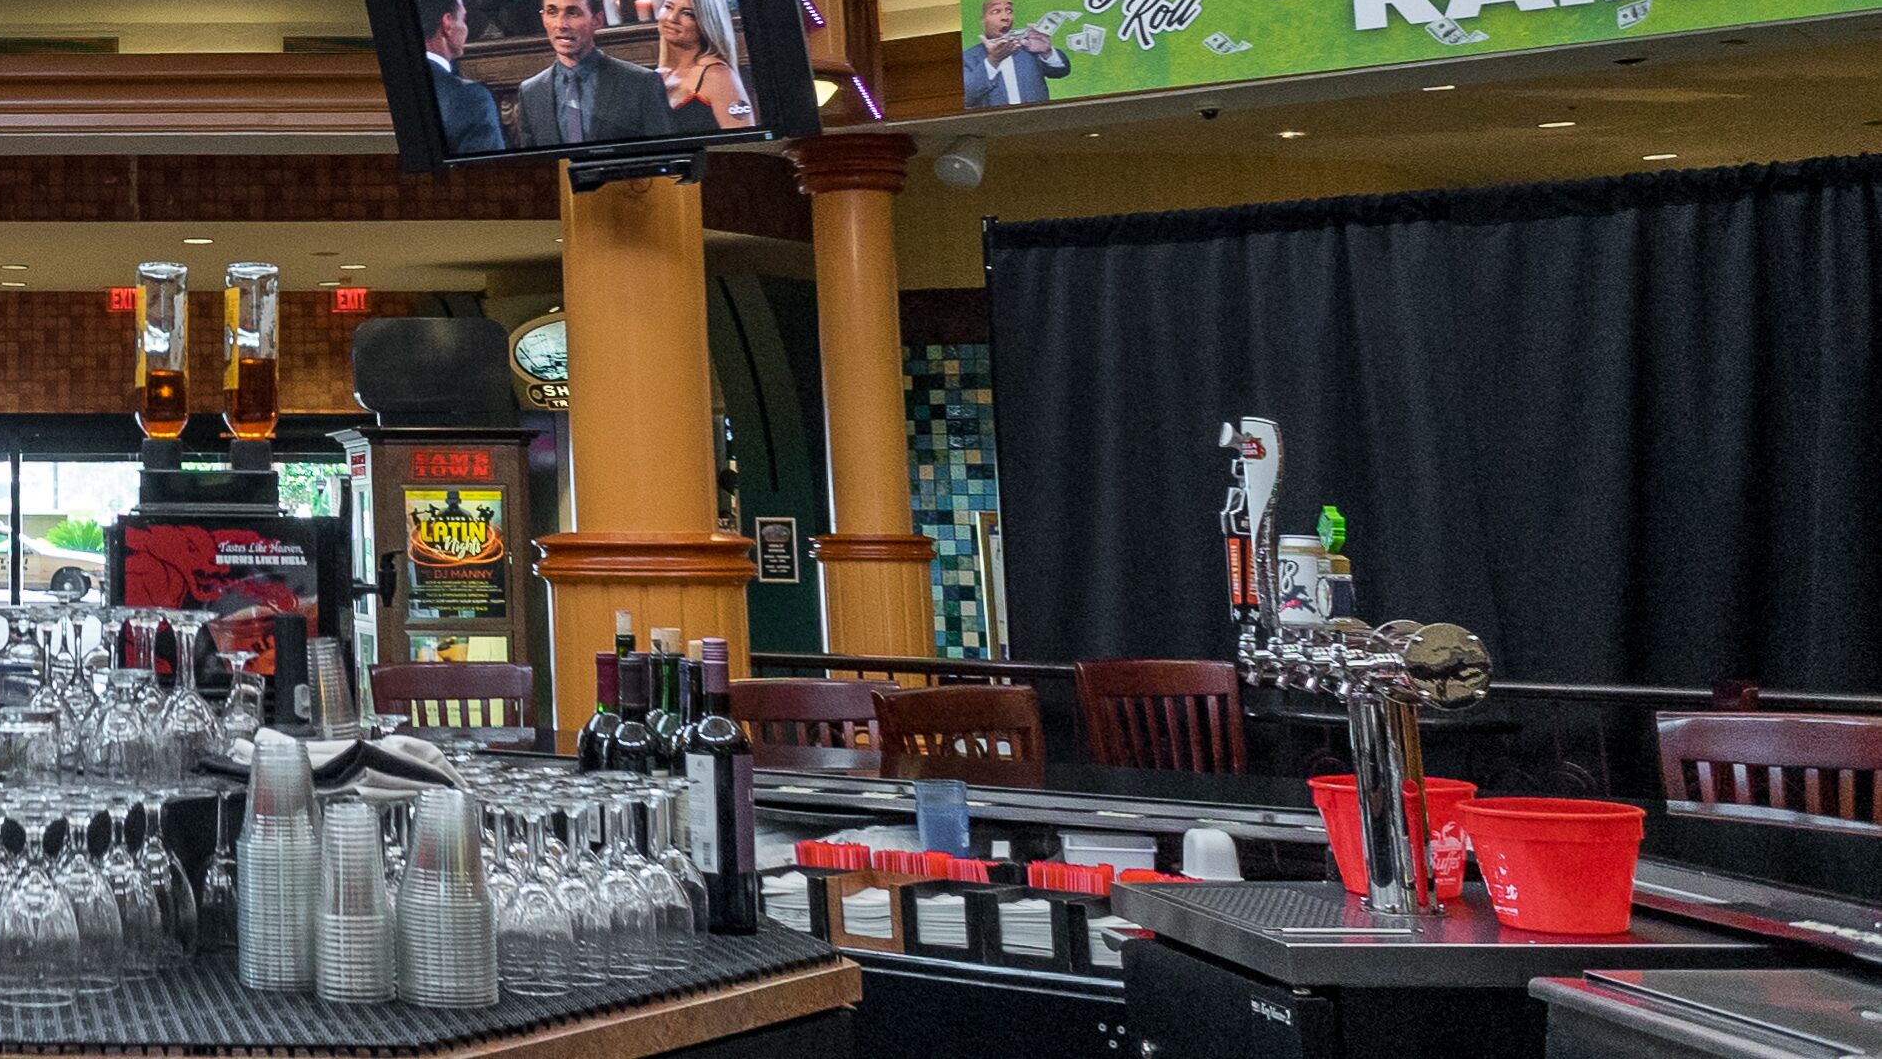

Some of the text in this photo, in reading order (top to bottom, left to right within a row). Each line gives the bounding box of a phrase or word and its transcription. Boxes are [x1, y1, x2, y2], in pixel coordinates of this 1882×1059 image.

[336, 288, 367, 310] EXIT
[542, 385, 570, 396] SH
[414, 465, 489, 477] TOWN
[420, 521, 486, 543] LATIN
[442, 535, 482, 559] Nights
[215, 554, 307, 566] BURNS LIKE HELL
[451, 569, 494, 579] MANNY
